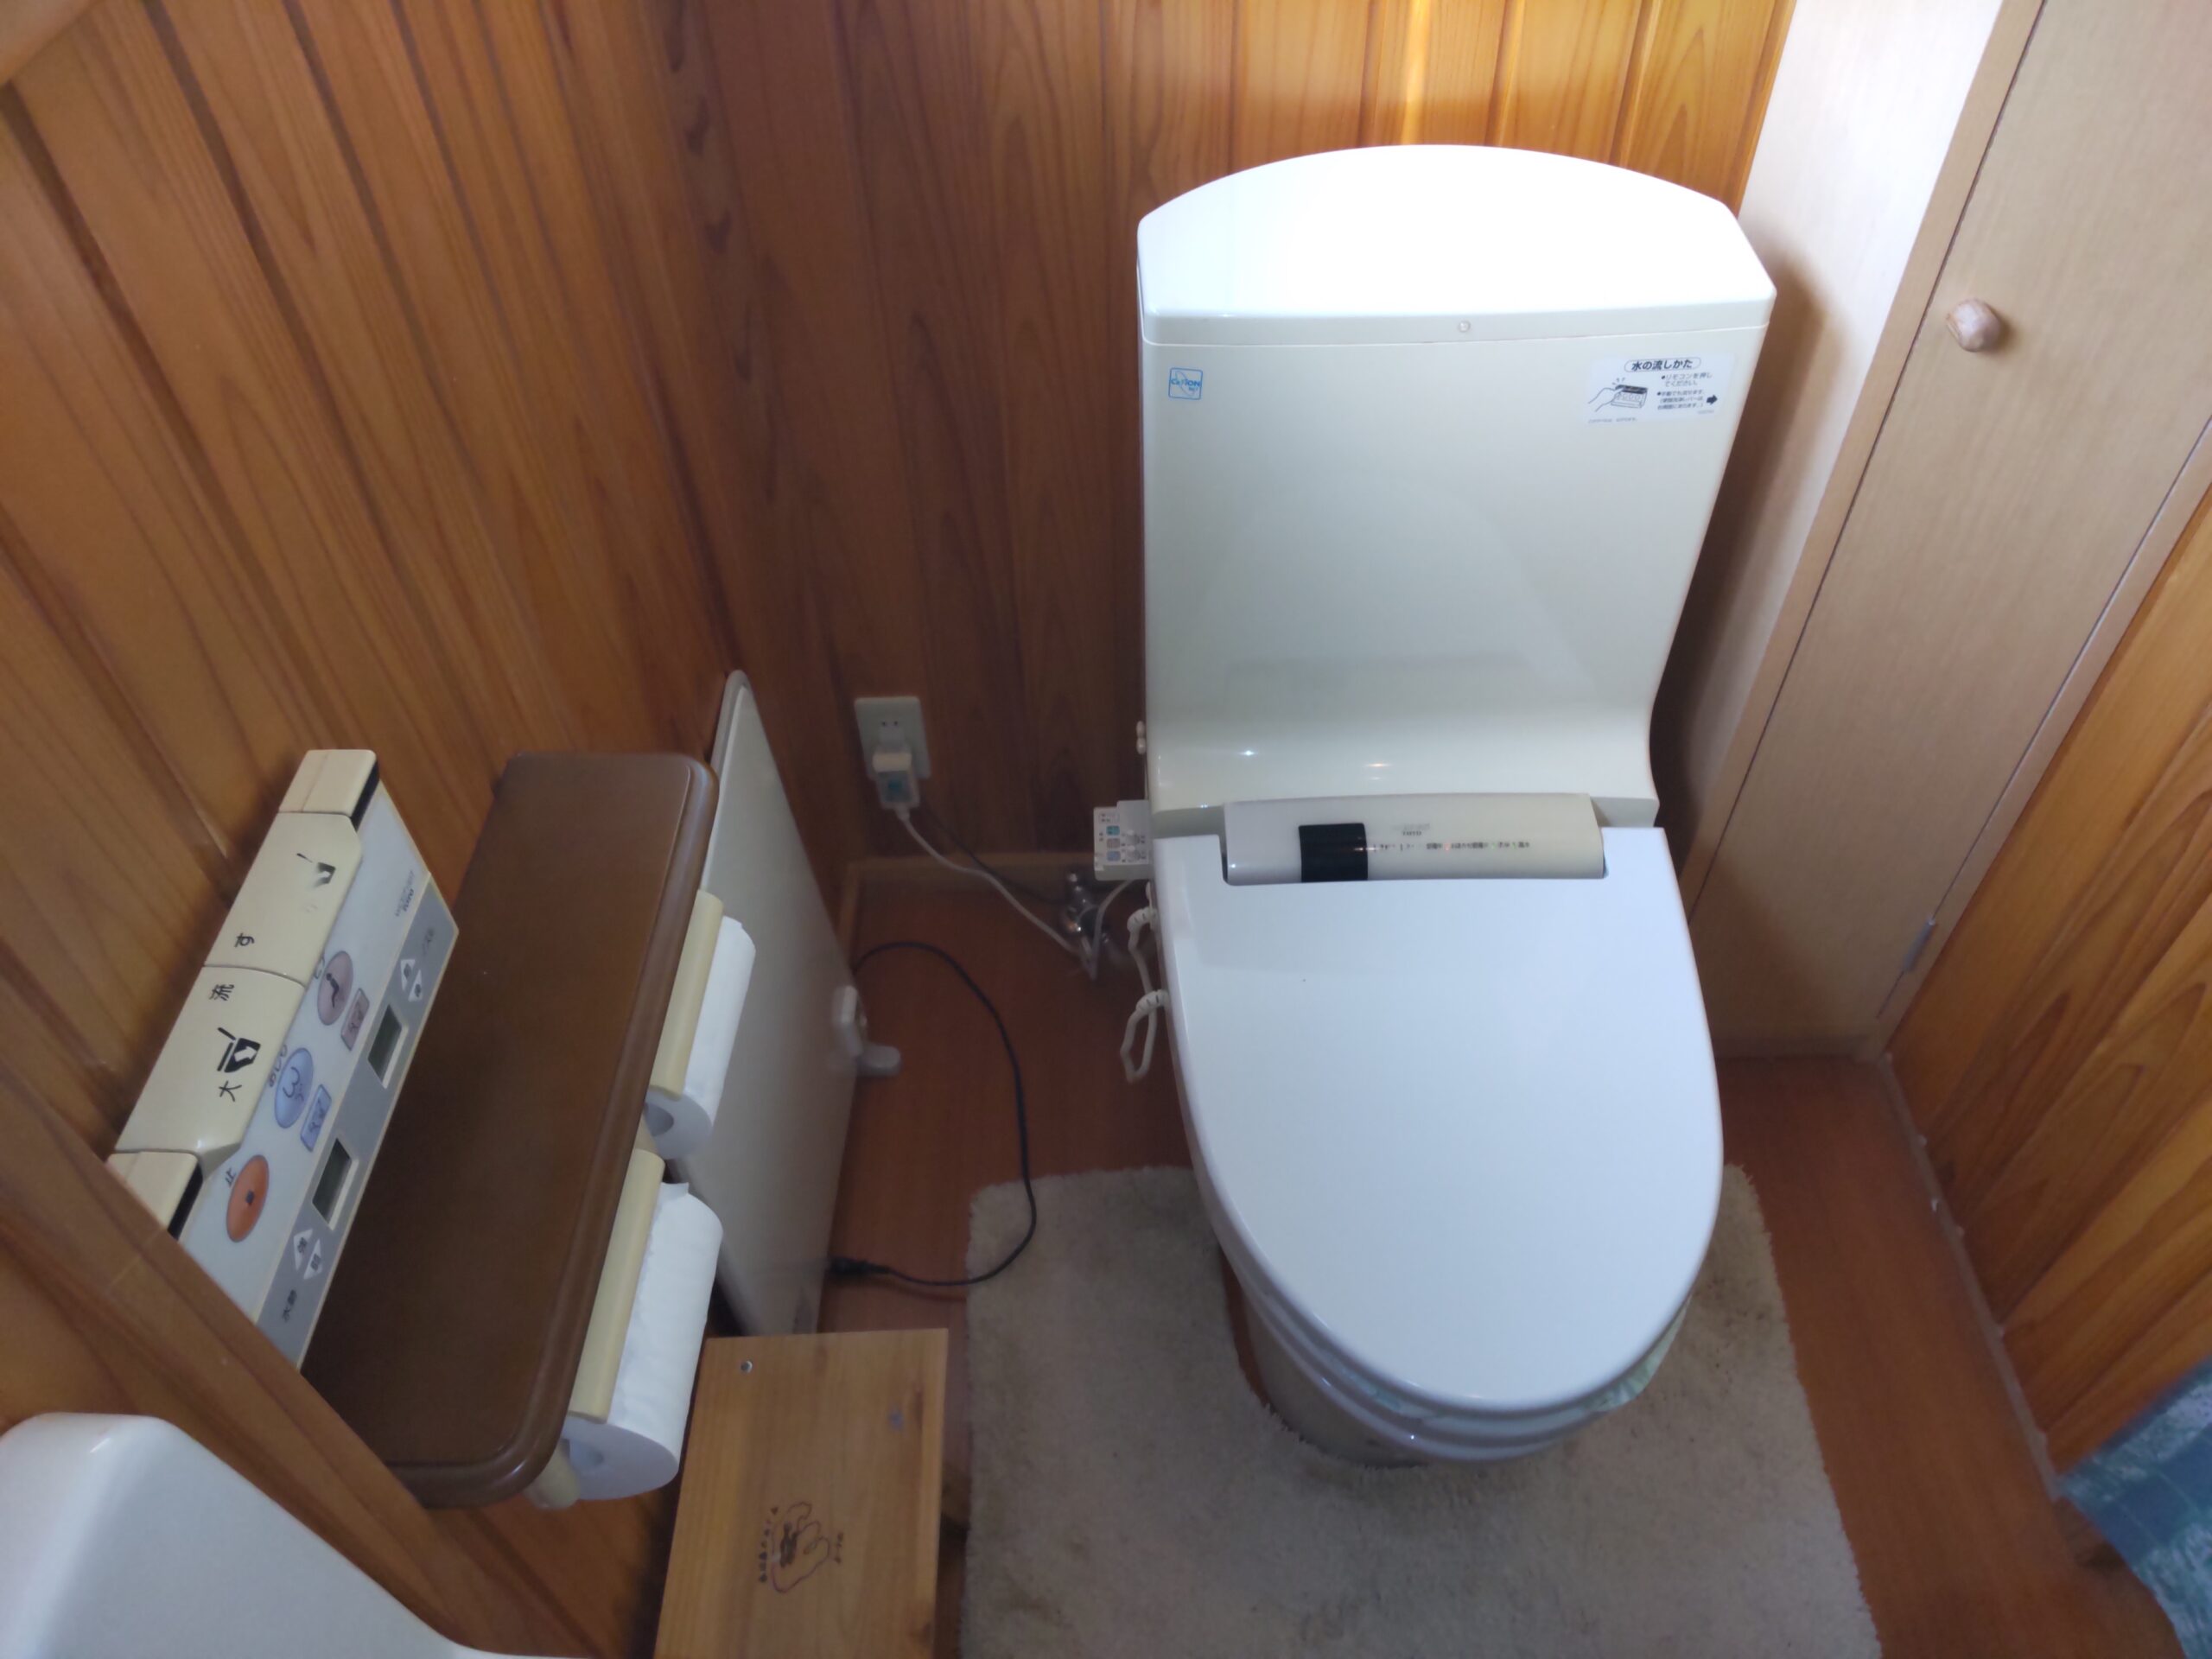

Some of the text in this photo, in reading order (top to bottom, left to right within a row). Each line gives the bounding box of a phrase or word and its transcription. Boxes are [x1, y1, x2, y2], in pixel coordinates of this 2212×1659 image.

[1631, 359, 1693, 372] 水の流しかた
[209, 933, 255, 1001] 流 す
[219, 1080, 242, 1102] 大
[225, 1166, 237, 1187] 止
